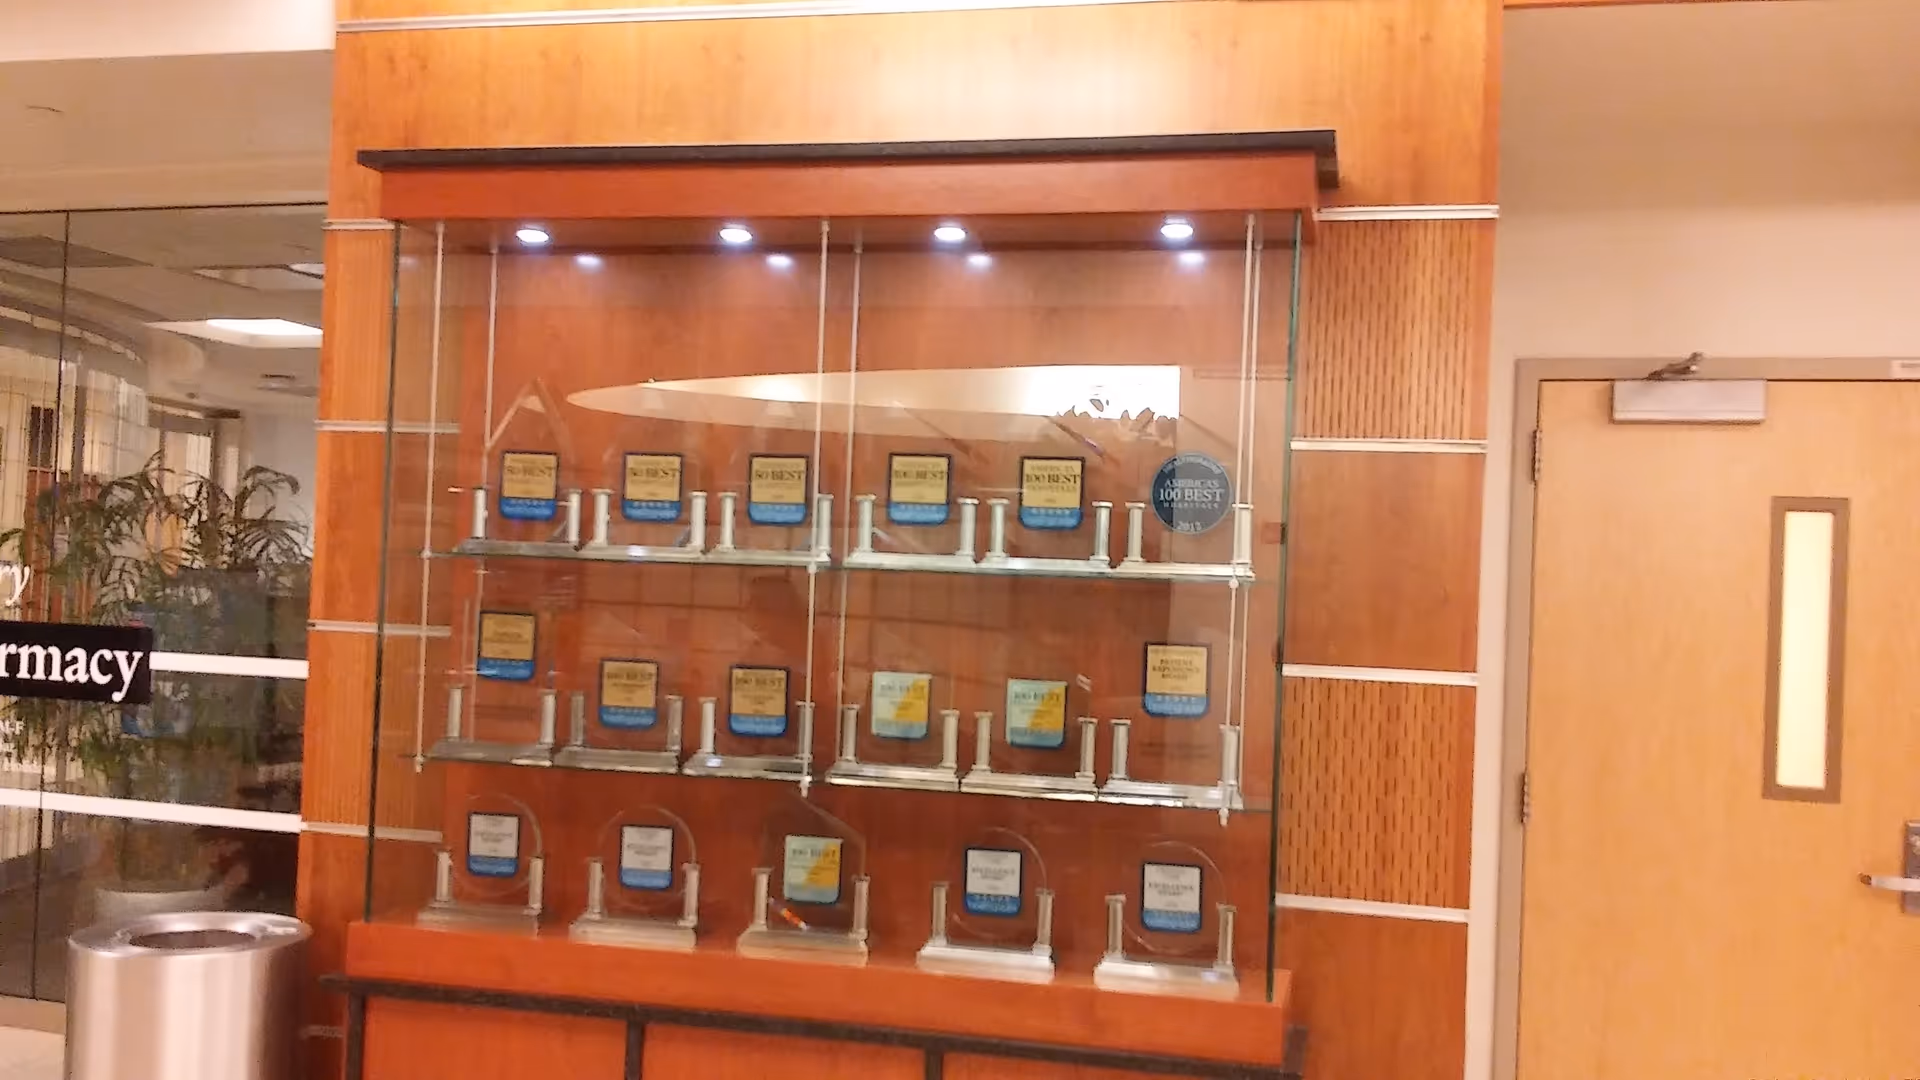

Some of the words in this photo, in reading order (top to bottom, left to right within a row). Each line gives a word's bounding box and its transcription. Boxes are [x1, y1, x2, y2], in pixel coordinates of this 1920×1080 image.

[755, 469, 769, 480] 50
[771, 469, 804, 481] BEST
[915, 470, 945, 481] BEST
[1025, 473, 1046, 484] 100
[1047, 473, 1080, 485] BEST
[1159, 488, 1181, 502] 100
[1184, 488, 1225, 502] BEST
